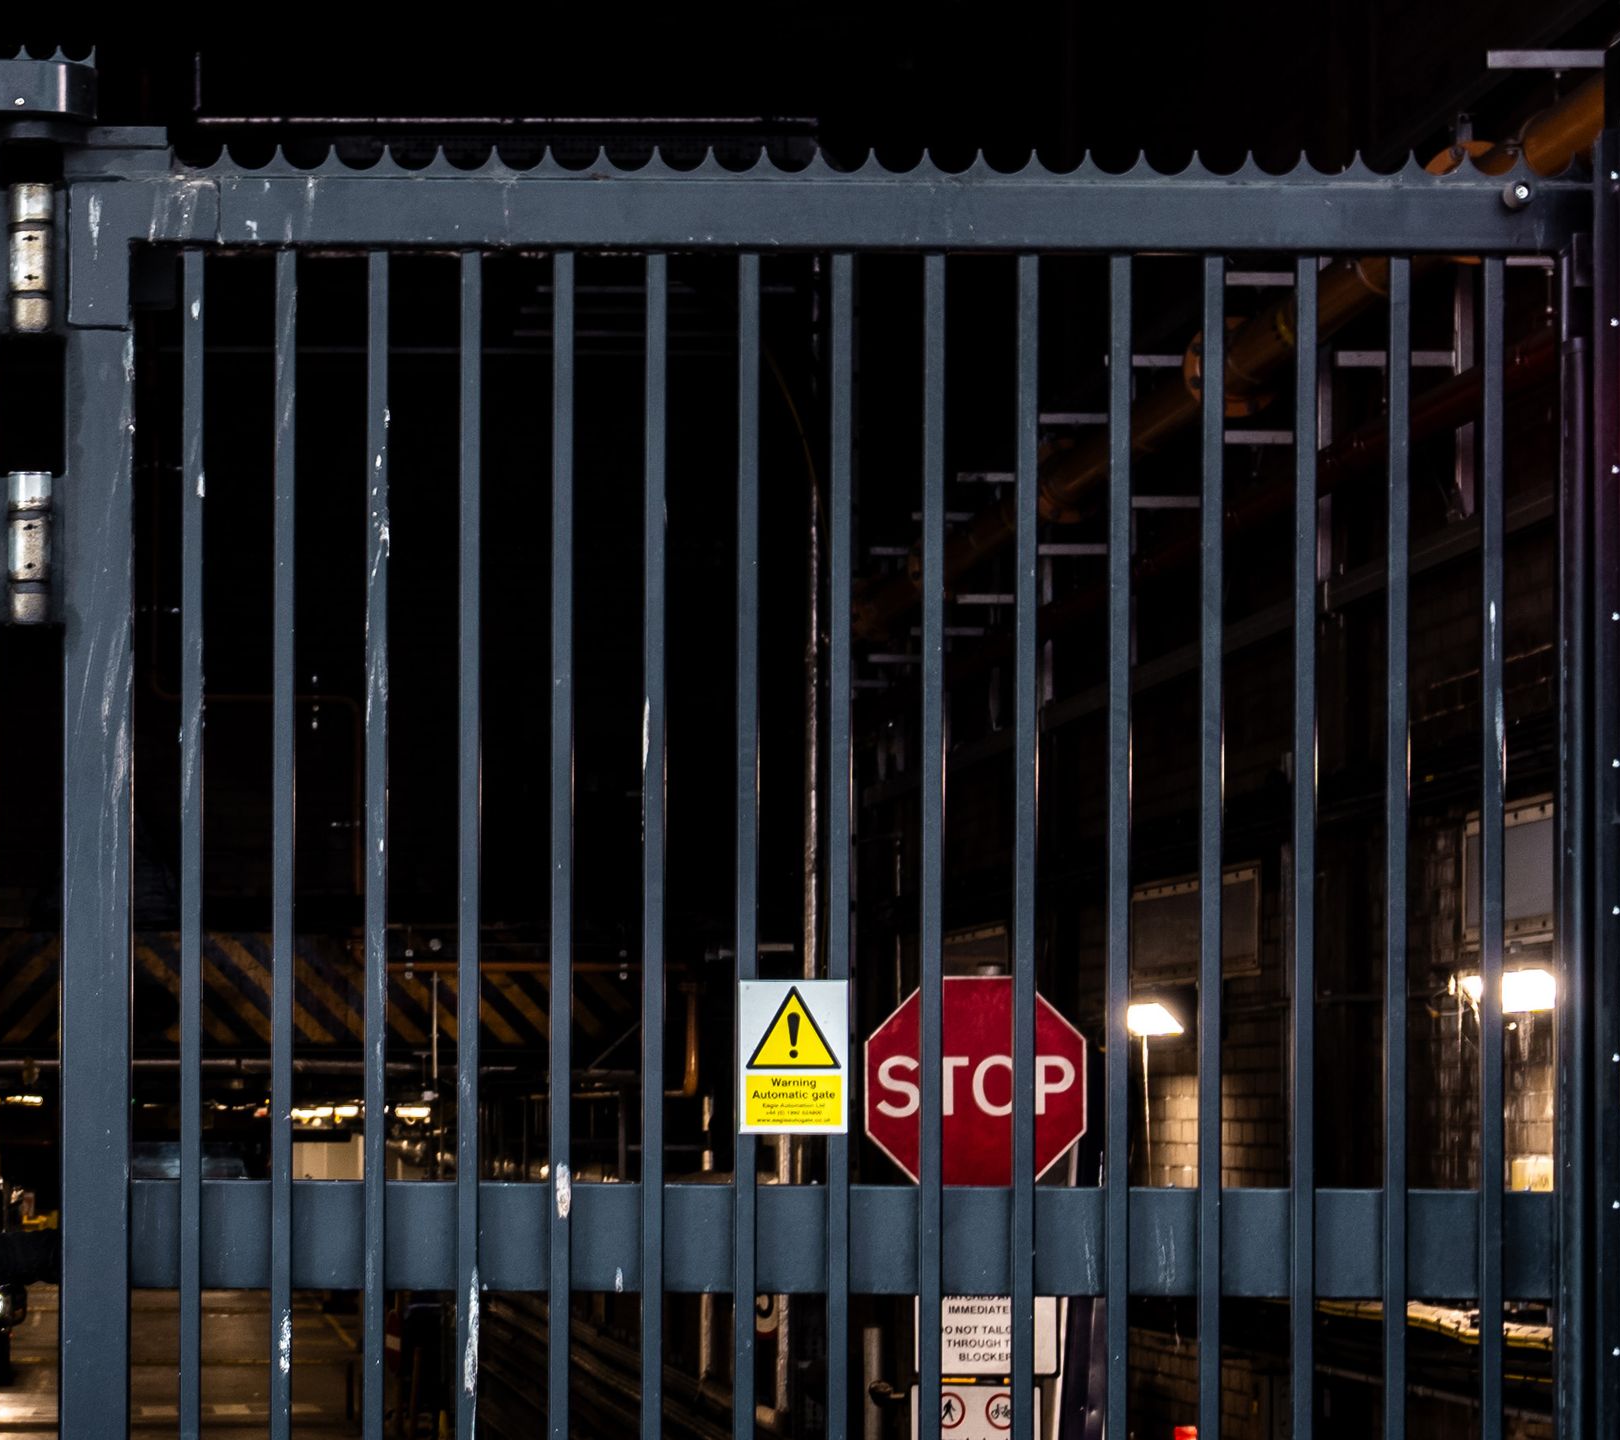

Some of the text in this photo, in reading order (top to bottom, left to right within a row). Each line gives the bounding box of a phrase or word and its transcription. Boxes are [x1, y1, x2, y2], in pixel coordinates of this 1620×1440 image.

[771, 1078, 817, 1089] Warning
[876, 1054, 1076, 1118] STOP
[752, 1090, 835, 1101] Automatic gate
[955, 1326, 978, 1334] NOT
[947, 1340, 1001, 1348] THROUGH
